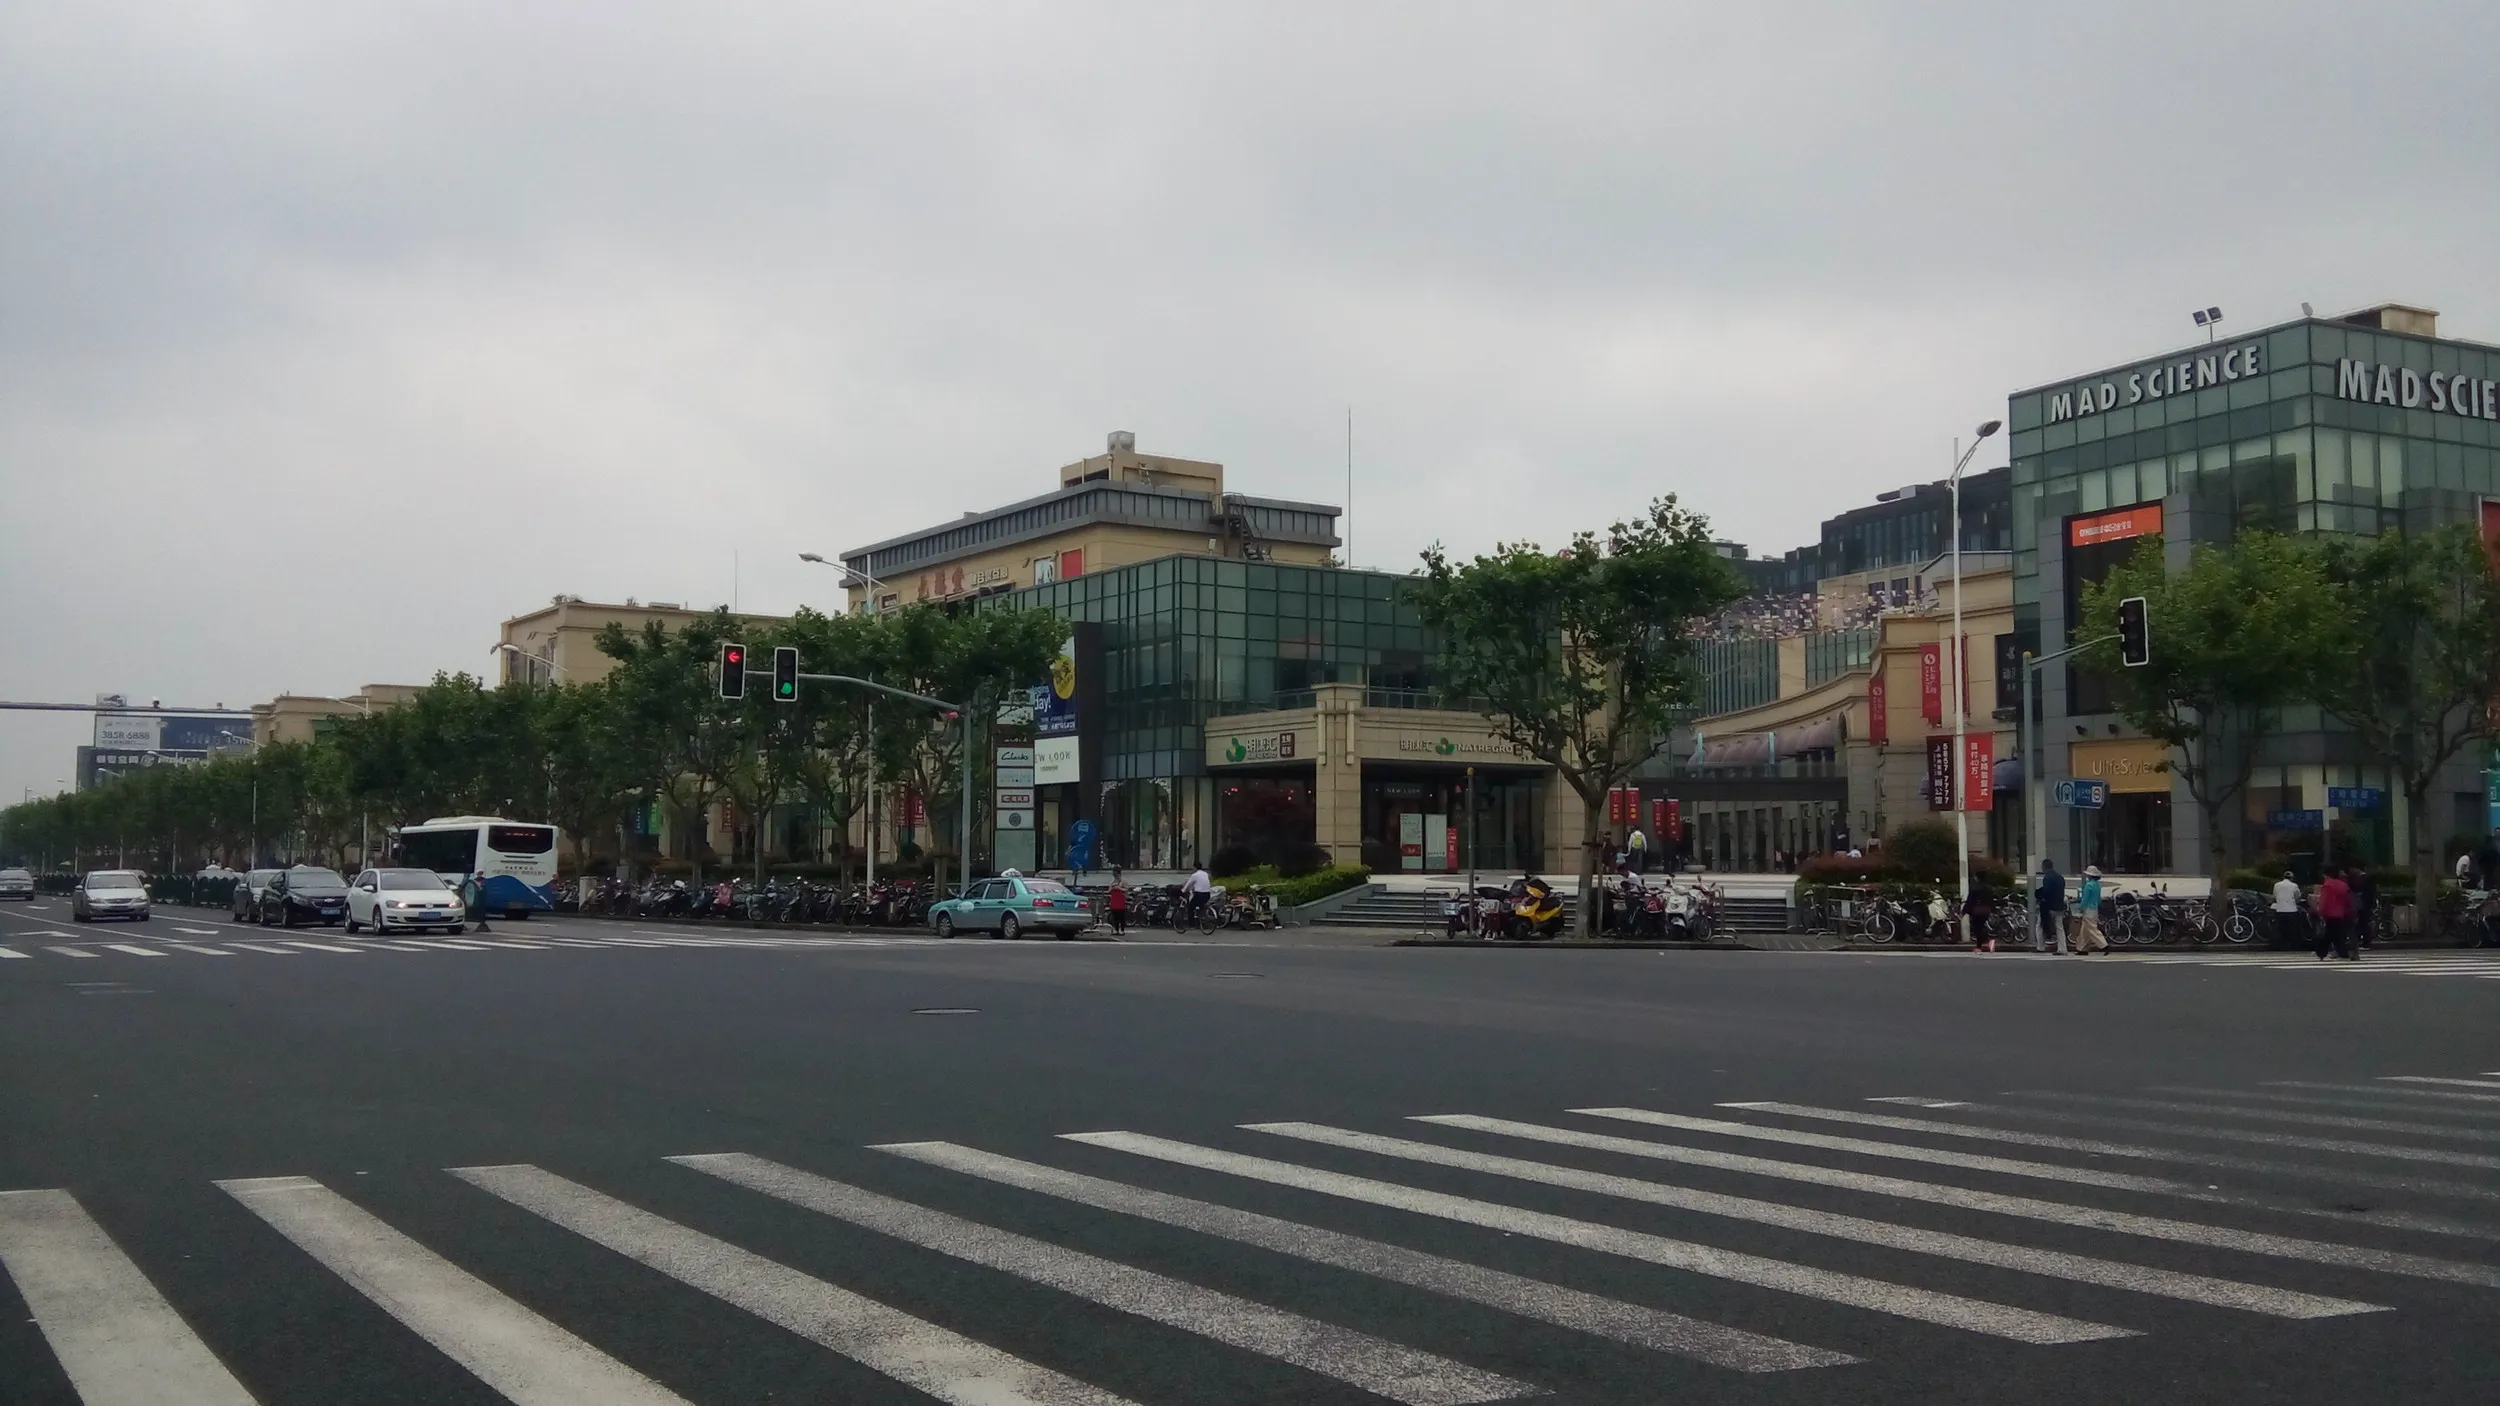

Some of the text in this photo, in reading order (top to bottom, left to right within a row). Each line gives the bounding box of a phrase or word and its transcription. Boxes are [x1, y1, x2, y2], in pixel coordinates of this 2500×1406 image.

[2050, 344, 2261, 423] MAD SCIENCE
[2338, 357, 2499, 421] MAD SCIE
[1457, 743, 1513, 754] NATREGRO
[1034, 753, 1045, 764] EW
[2092, 758, 2151, 776] UlifeStyle
